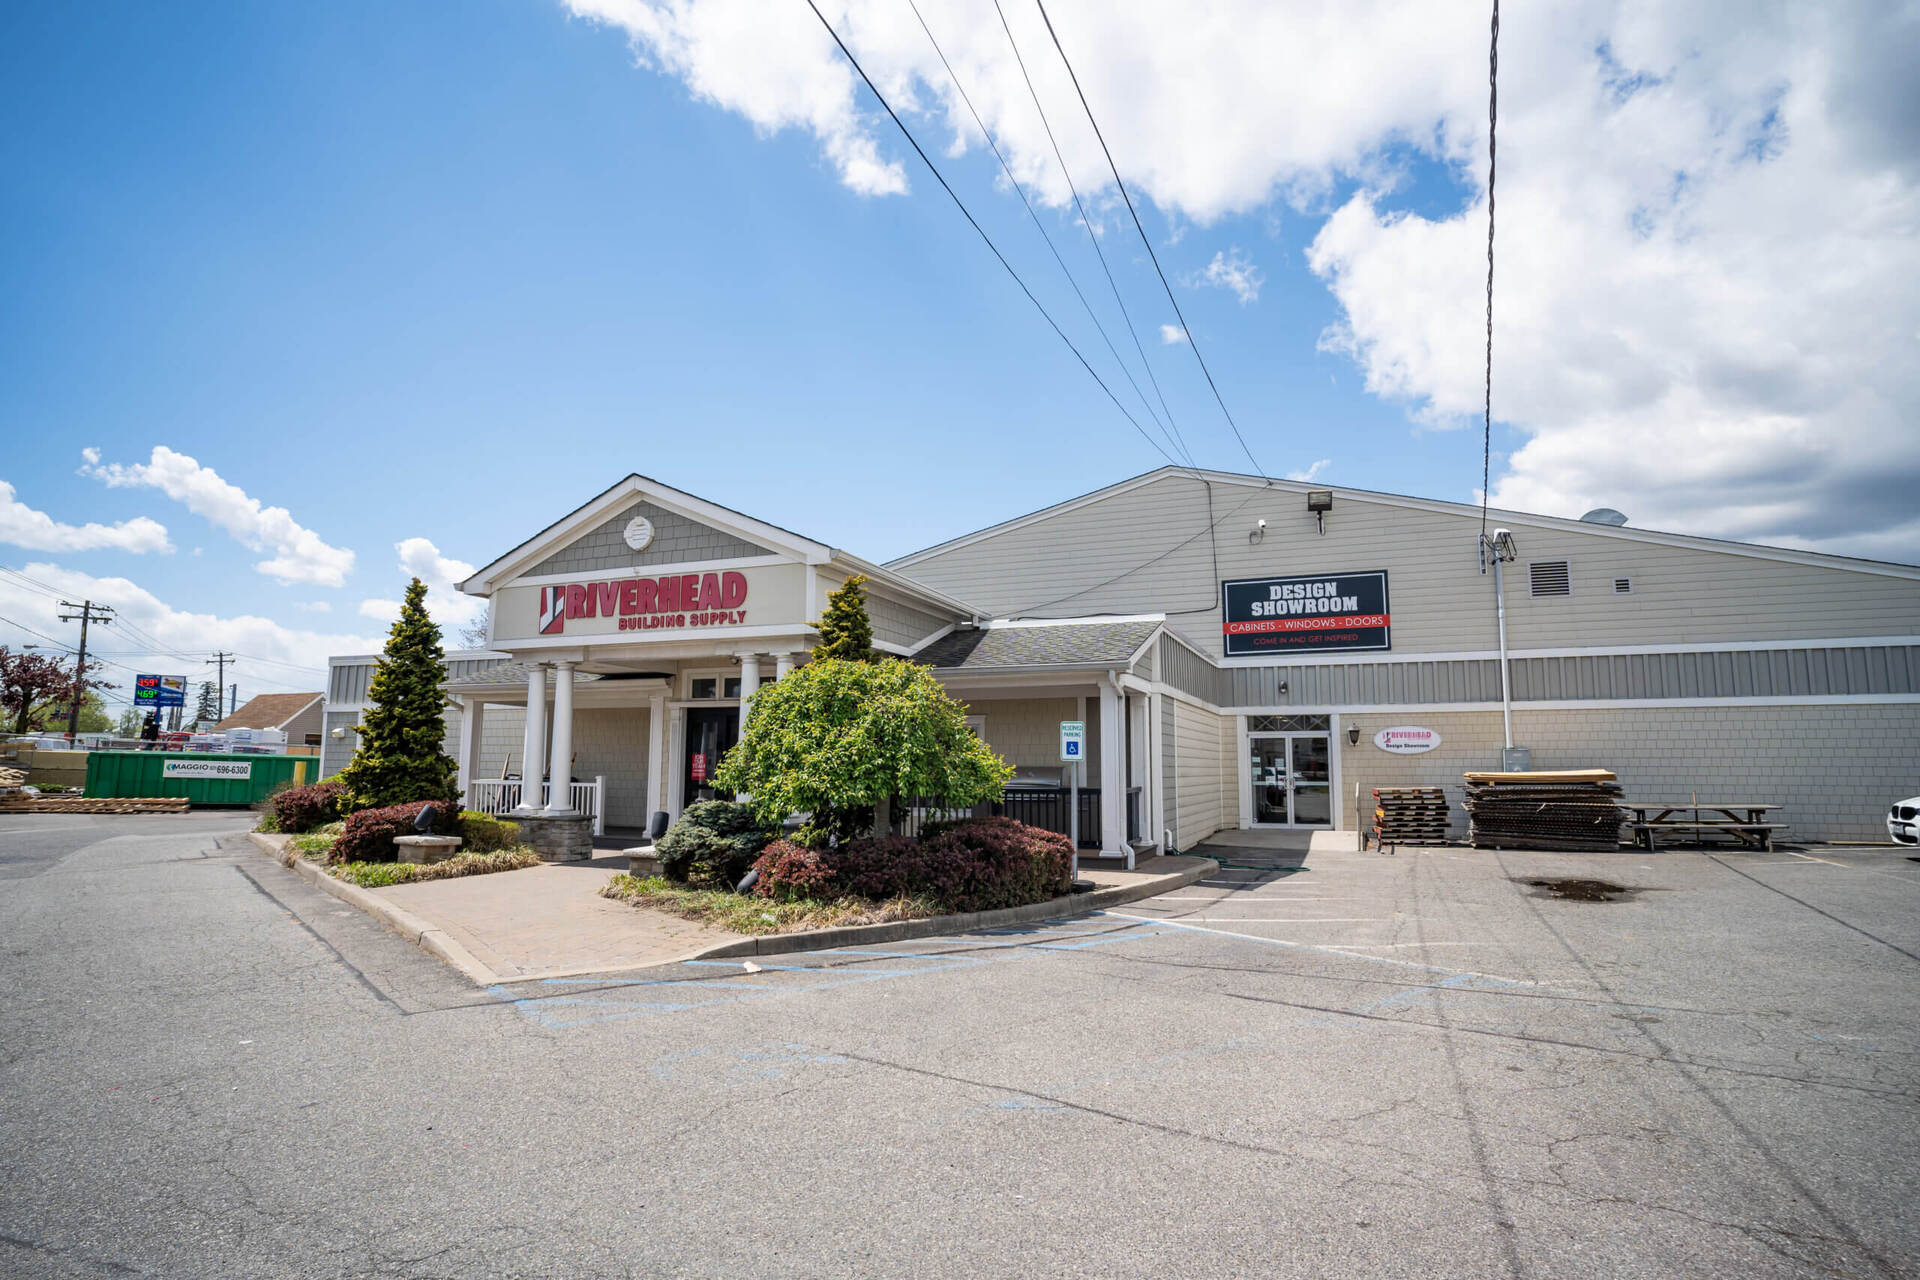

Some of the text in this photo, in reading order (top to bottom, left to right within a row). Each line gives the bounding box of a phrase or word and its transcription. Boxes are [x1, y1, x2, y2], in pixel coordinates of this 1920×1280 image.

[566, 572, 748, 619] RIVERHEAD
[1270, 582, 1337, 600] DESIGN
[1251, 596, 1359, 617] SHOWROOM
[618, 610, 747, 631] BUILDING SUPPLY
[1229, 622, 1276, 633] CABINETS
[1284, 618, 1336, 630] WINDOWS
[1345, 616, 1384, 627] DOORS
[1253, 633, 1359, 646] COME IN AND GET INSPIRED
[1391, 731, 1431, 739] RIVERHEAD
[174, 763, 209, 771] MAGGIO
[217, 765, 248, 774] 696-6300
